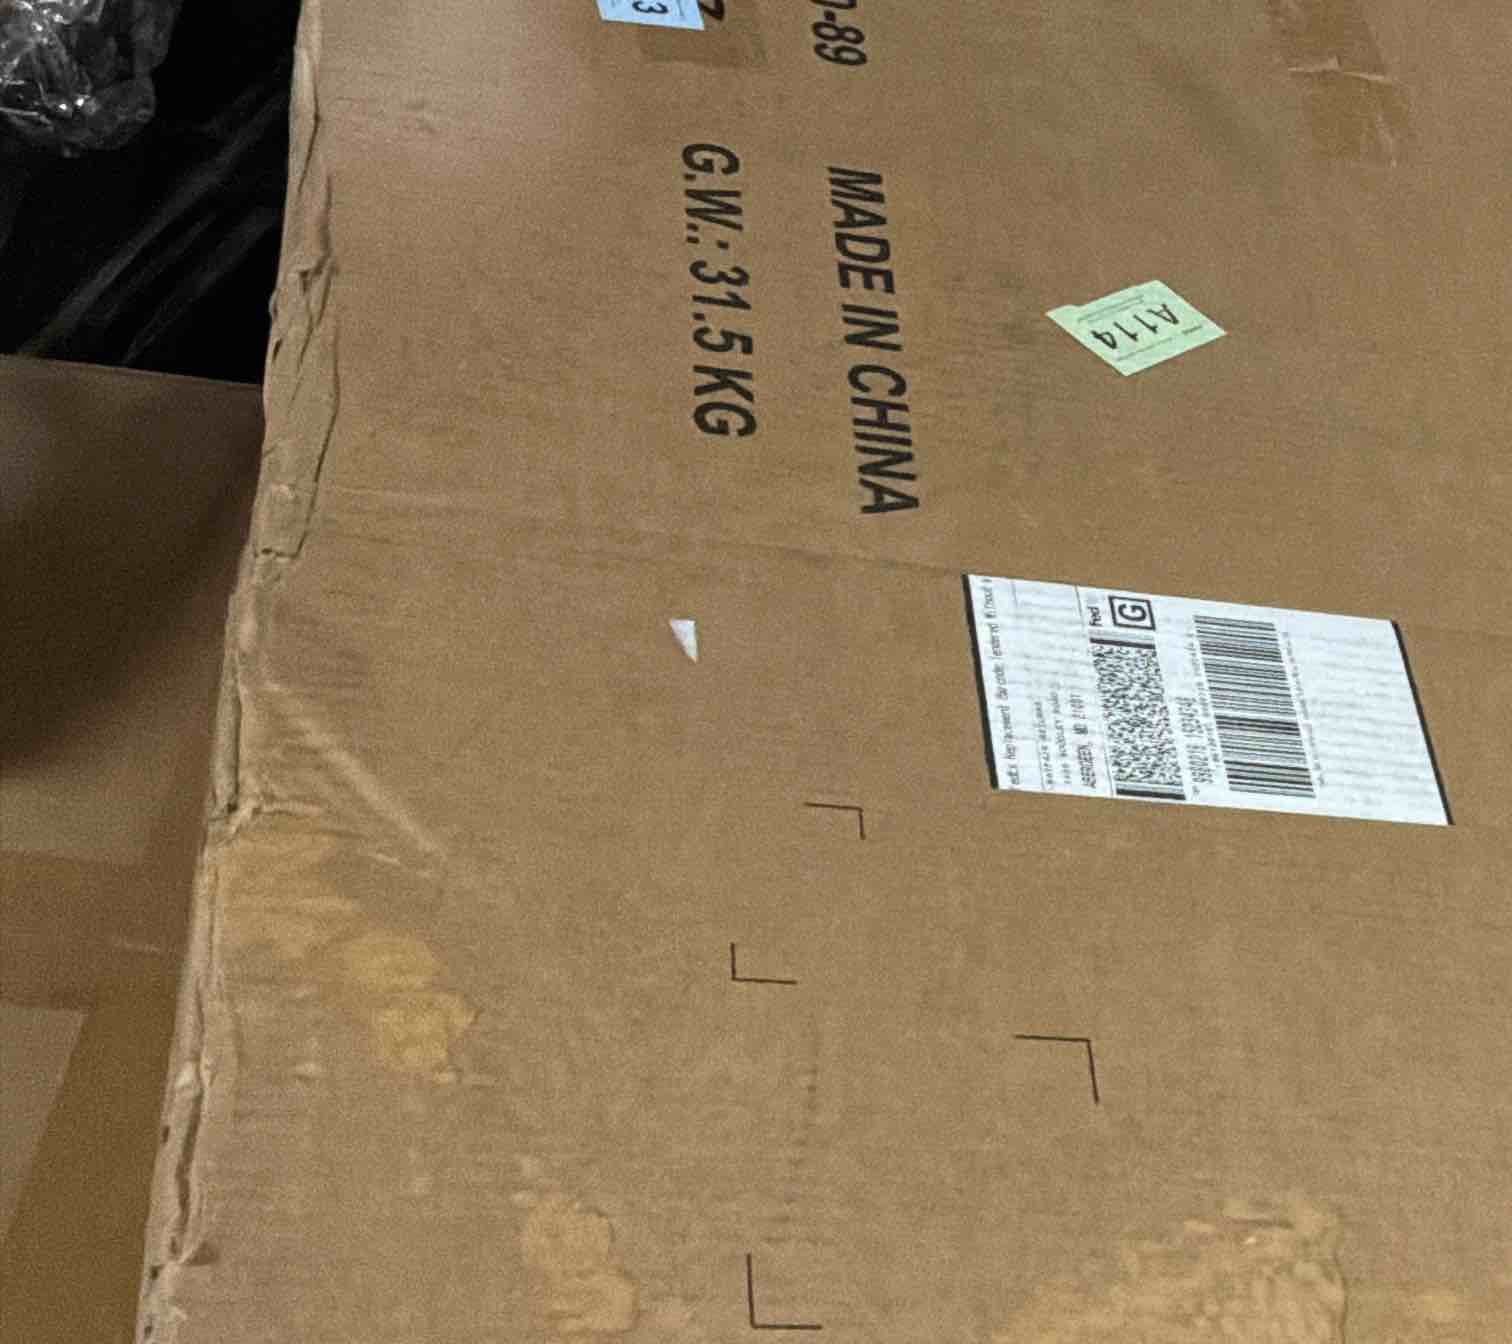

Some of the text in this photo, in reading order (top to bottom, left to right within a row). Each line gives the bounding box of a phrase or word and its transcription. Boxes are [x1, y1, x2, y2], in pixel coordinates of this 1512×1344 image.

[827, 165, 921, 516] MADE IN CHINA
[1092, 303, 1181, 350] A114
[1116, 602, 1148, 622] G
